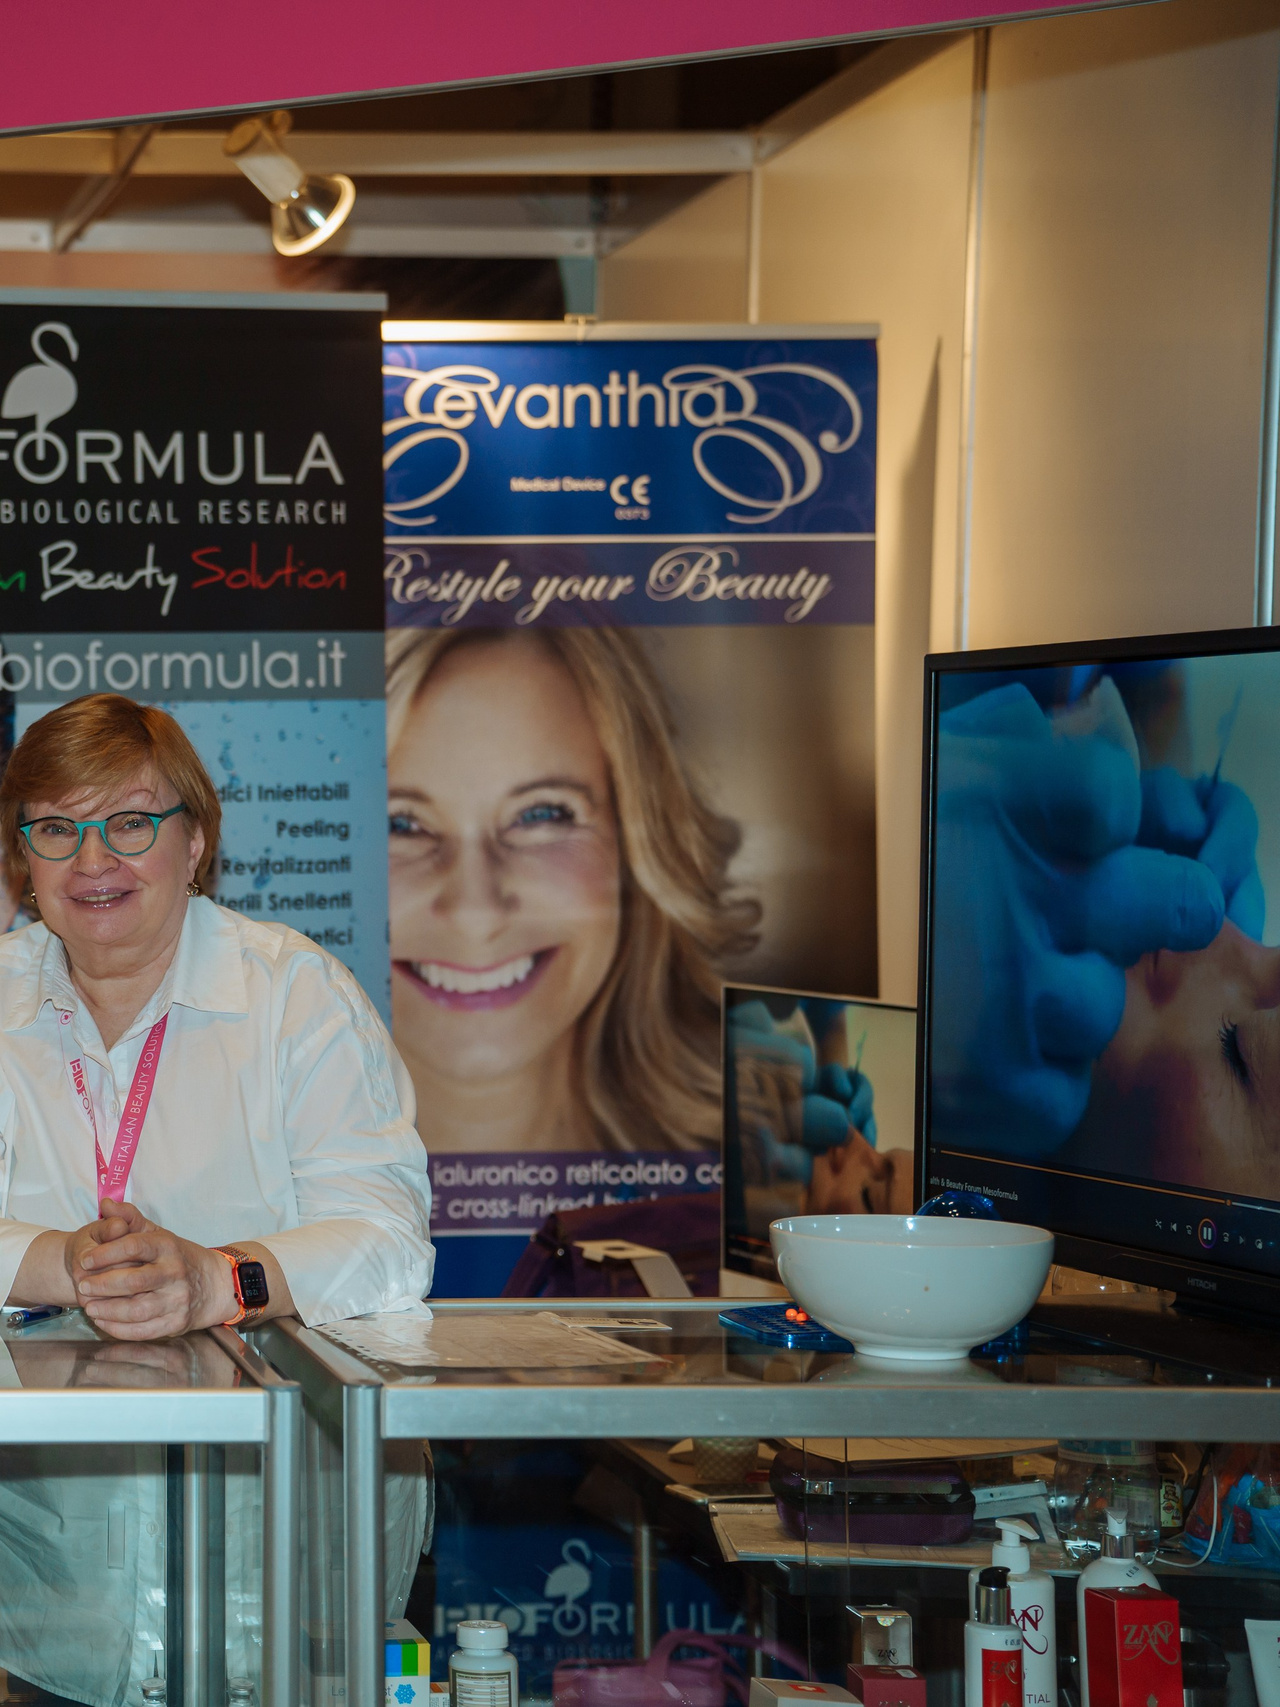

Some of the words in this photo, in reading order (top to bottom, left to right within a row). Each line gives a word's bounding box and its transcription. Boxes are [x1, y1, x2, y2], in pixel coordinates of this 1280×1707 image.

[0, 499, 180, 525] BIOLOGICAL
[198, 500, 347, 525] RESEARCH
[39, 539, 179, 616] Beauty
[191, 541, 347, 591] Solution
[515, 571, 635, 626] your
[646, 545, 833, 624] Beauty
[276, 819, 351, 842] Peeling
[221, 855, 352, 876] Revitalizzanti
[268, 892, 353, 912] Snellenti
[110, 1164, 126, 1187] THE
[119, 1116, 139, 1166] ITALIAN
[129, 1071, 151, 1115] BEAUTY
[565, 1159, 688, 1186] reticolato
[946, 1179, 965, 1191] Beauty
[965, 1183, 982, 1194] Forum
[982, 1186, 1019, 1201] Mesoformula
[1187, 1277, 1217, 1291] HITACHI
